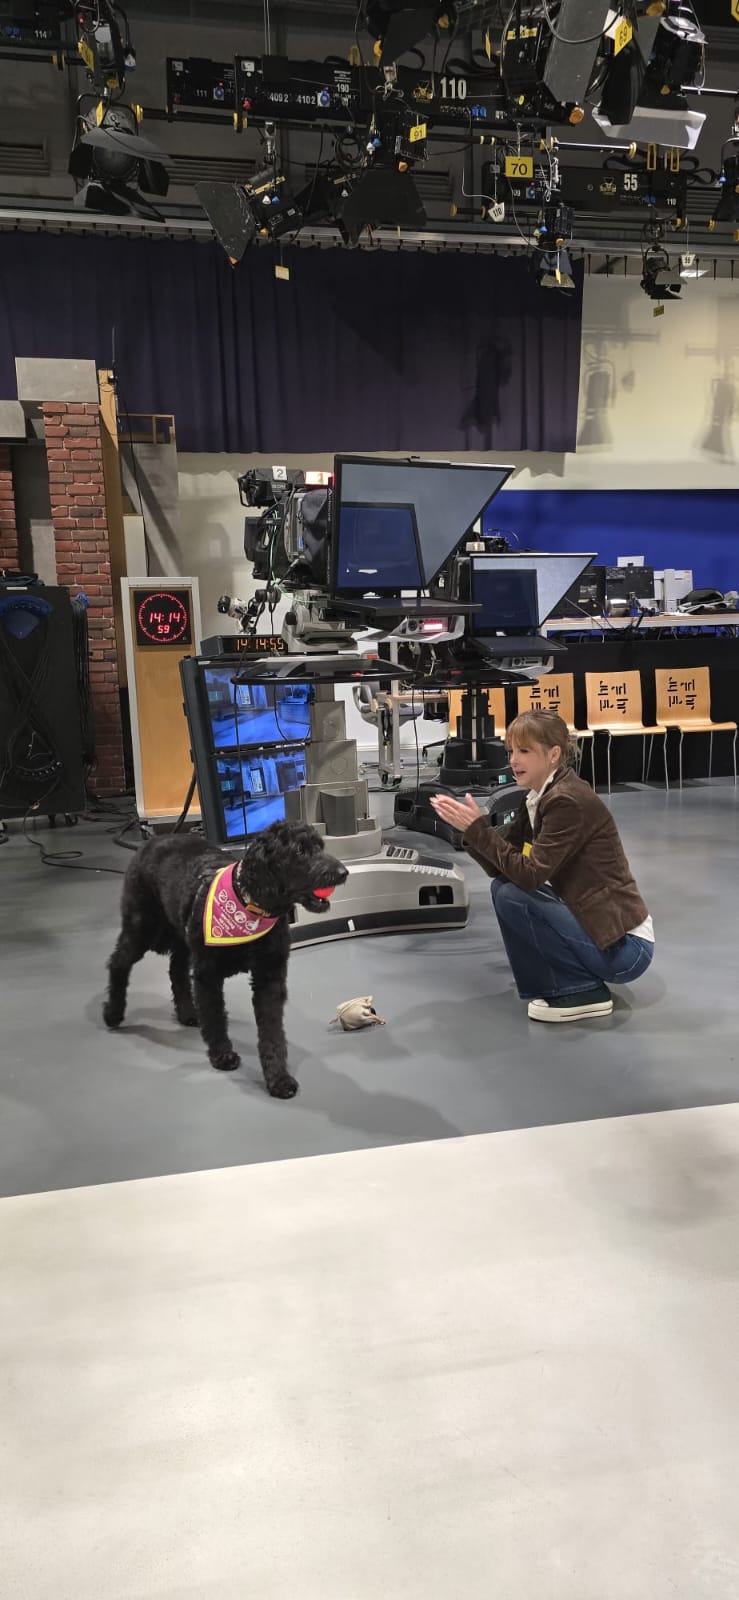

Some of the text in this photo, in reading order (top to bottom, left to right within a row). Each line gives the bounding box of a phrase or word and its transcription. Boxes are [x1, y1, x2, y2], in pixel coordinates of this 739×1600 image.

[34, 30, 48, 39] 114
[336, 83, 350, 93] 190
[440, 76, 467, 100] 110
[511, 163, 528, 176] 70
[623, 173, 638, 191] 55
[666, 198, 677, 206] 110
[276, 468, 284, 478] 2
[157, 625, 170, 634] 59
